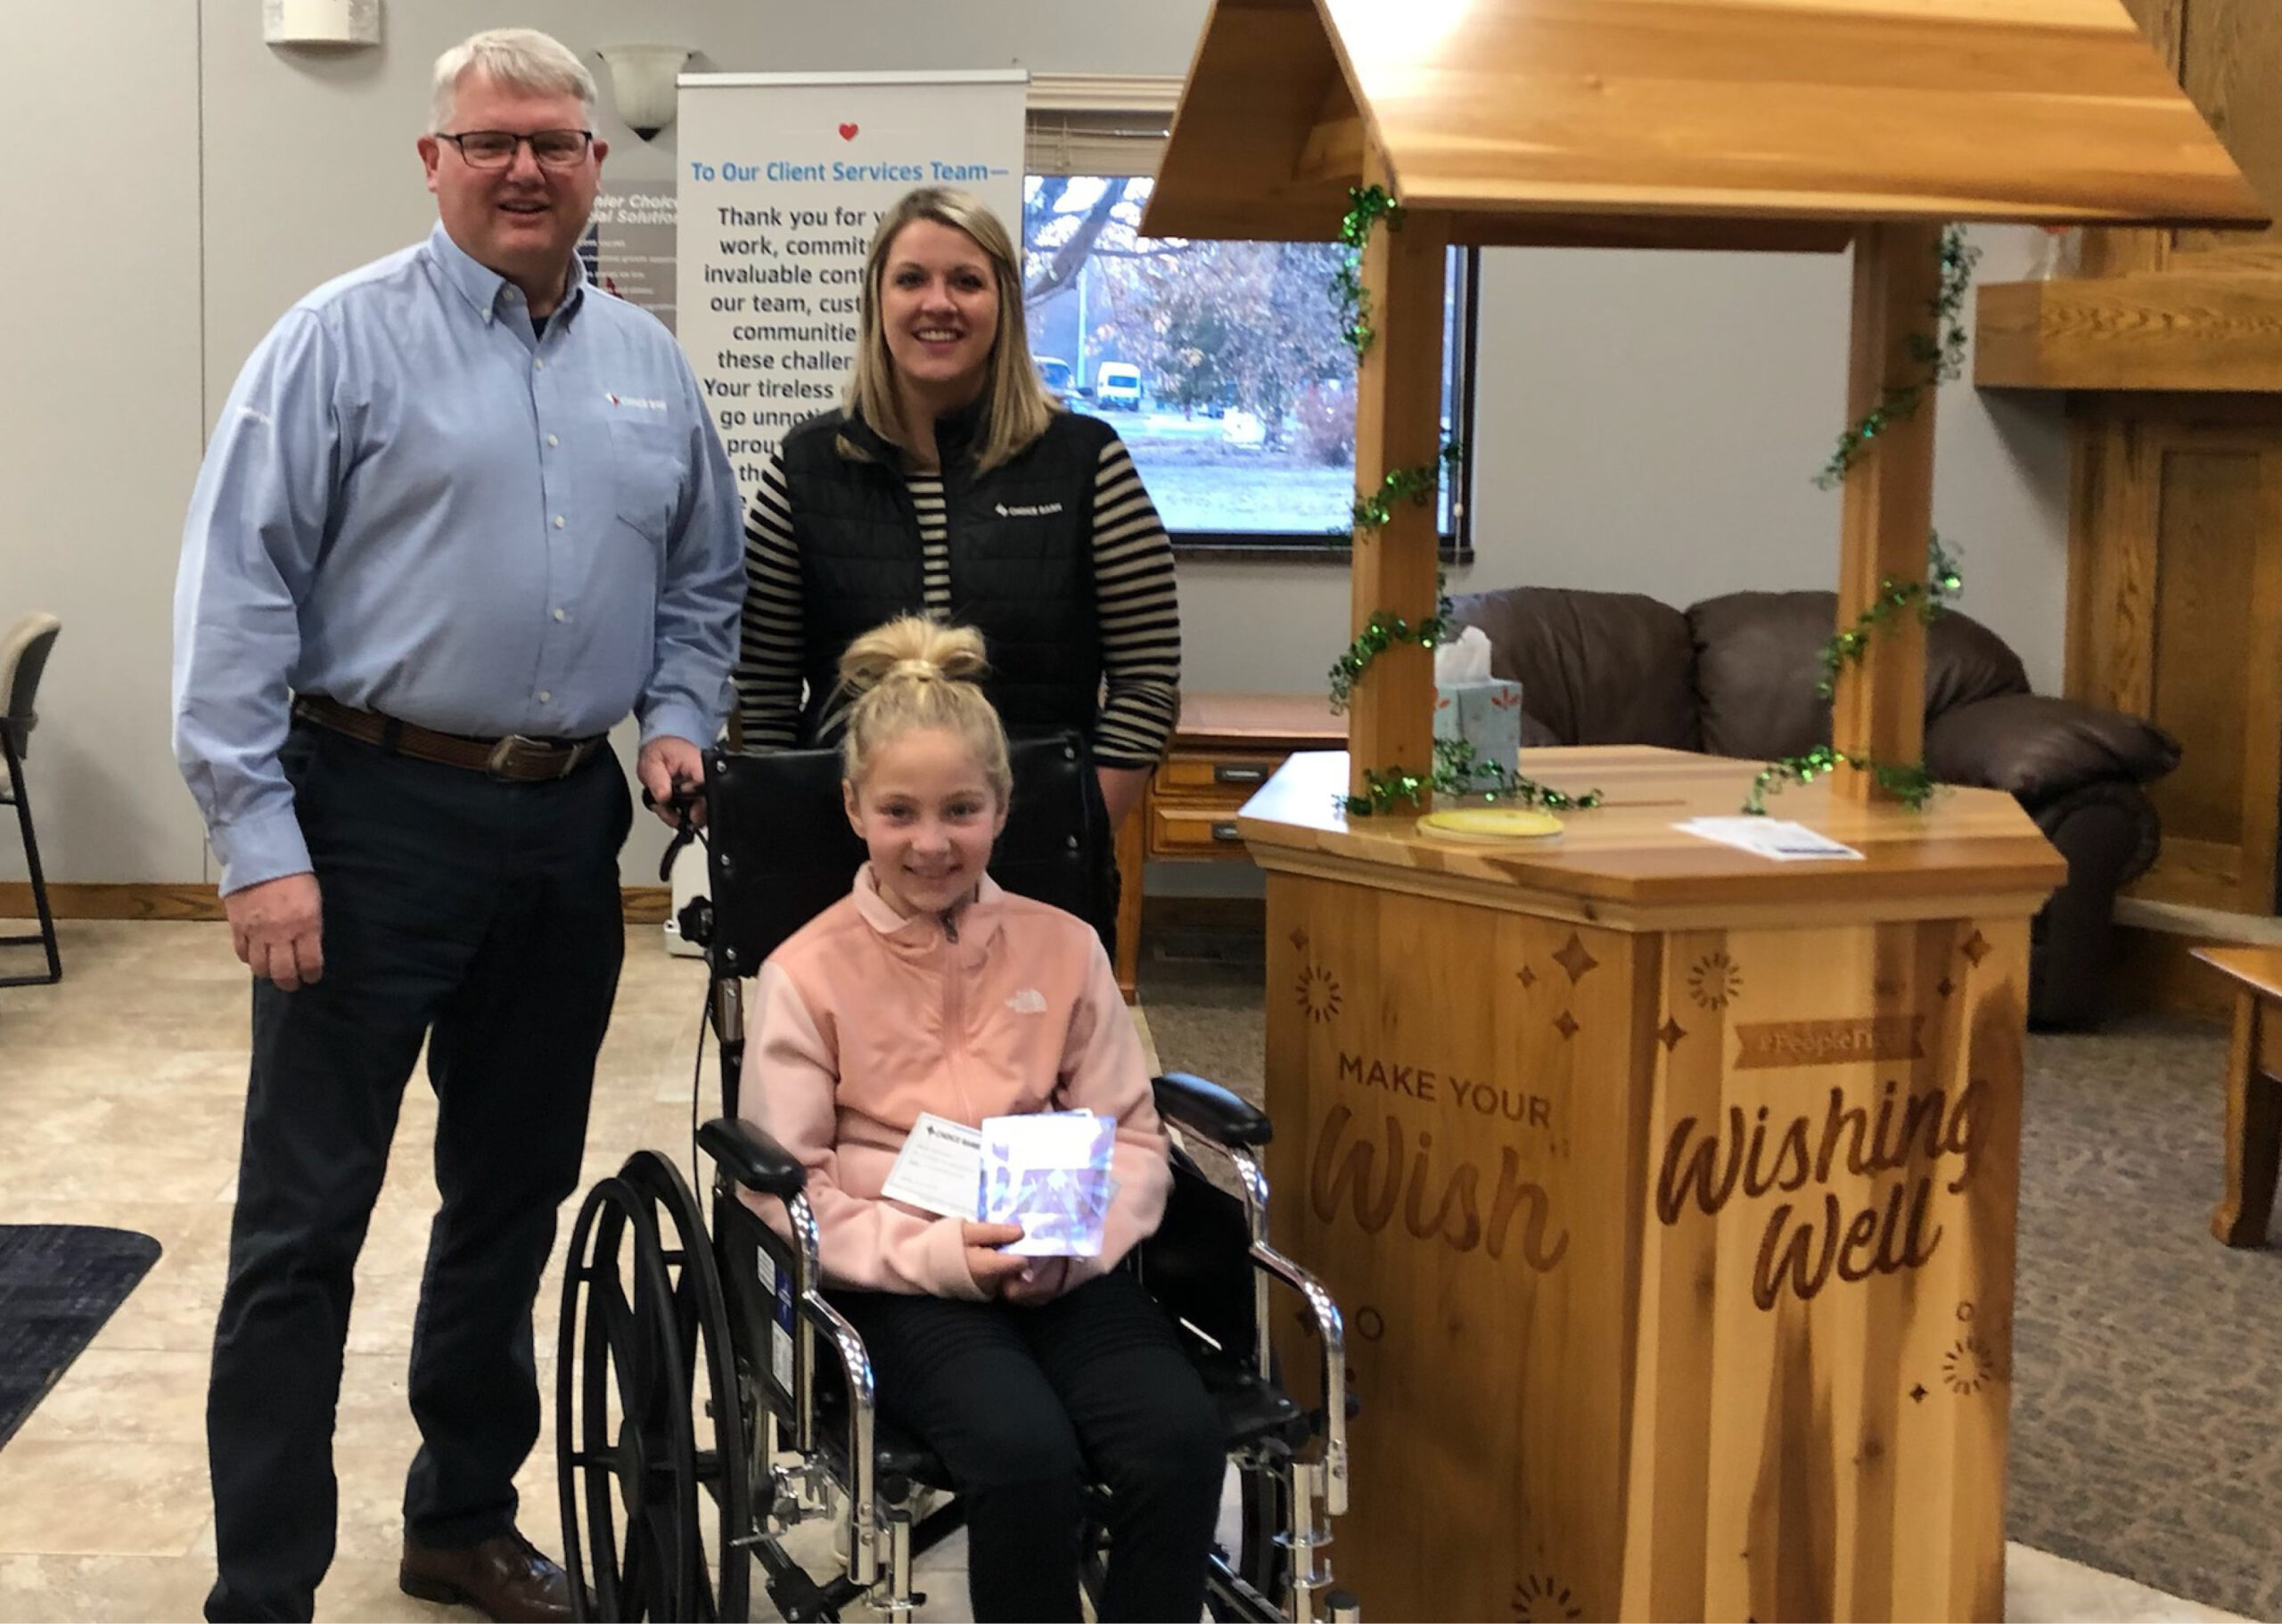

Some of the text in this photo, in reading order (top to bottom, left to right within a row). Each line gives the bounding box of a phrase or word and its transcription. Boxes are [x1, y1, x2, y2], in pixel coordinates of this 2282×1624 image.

[691, 162, 715, 181] To
[721, 162, 759, 182] Our
[767, 161, 825, 181] Client
[833, 161, 923, 182] Services
[718, 206, 782, 226] Thank
[790, 211, 828, 231] you
[834, 206, 866, 226] for
[719, 235, 778, 258] work,
[704, 264, 864, 284] invaluable cont
[710, 294, 861, 316] our team, cust
[733, 322, 858, 342] communitie
[717, 349, 775, 370] these
[704, 378, 751, 398] Your
[758, 378, 834, 398] tireless
[720, 410, 746, 431] go
[727, 438, 776, 457] prou
[1338, 1051, 1552, 1129] MAKE YOUR
[1656, 1079, 1991, 1226] Wishing
[1309, 1103, 1570, 1273] Wish
[1752, 1176, 1942, 1312] Well
